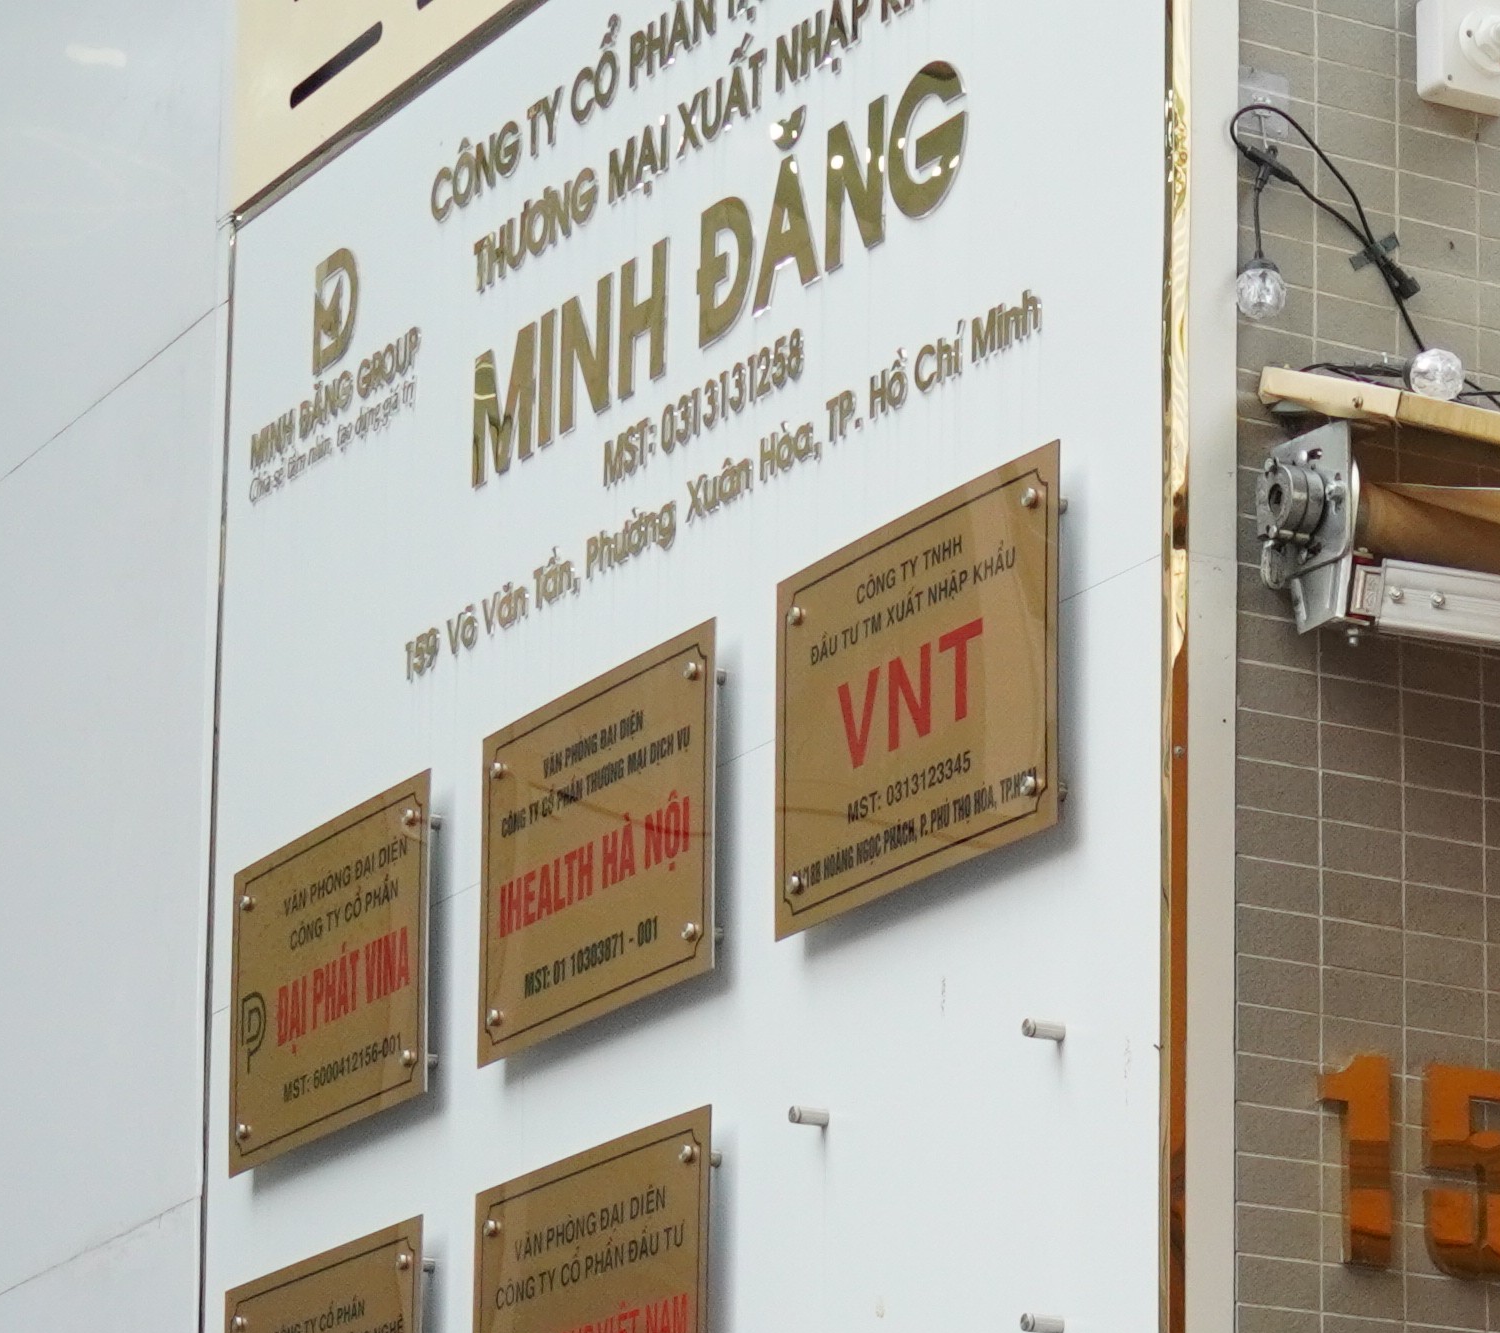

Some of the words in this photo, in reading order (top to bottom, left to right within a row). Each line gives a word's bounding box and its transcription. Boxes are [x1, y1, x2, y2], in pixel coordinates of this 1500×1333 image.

[431, 138, 522, 222] CÔNG
[527, 86, 564, 158] TY
[570, 14, 621, 125] CỔ
[473, 167, 599, 292] THƯƠNG
[608, 114, 671, 206] MẠI
[677, 33, 766, 159] XUẤT
[471, 236, 670, 489] MINH
[697, 60, 969, 349] ĐĂNG
[250, 408, 297, 472] MINH
[299, 370, 353, 440] ĐĂNG
[357, 326, 422, 400] GROUP
[603, 415, 657, 489] MST:
[661, 328, 806, 456] 0313131258
[404, 625, 440, 682] 159
[446, 603, 478, 657] Võ
[482, 578, 529, 637] Văn
[586, 500, 678, 578] Phường
[686, 458, 754, 524] Xuân
[826, 391, 864, 445] TP.
[869, 347, 910, 414] Hồ
[914, 319, 966, 394] Chí
[971, 288, 1044, 367] Minh
[810, 630, 839, 667] ĐẦU
[841, 624, 861, 651] TƯ
[863, 615, 882, 639] TM
[886, 587, 925, 626] XUẤT
[927, 568, 968, 608] NHẬP
[972, 540, 1017, 586] KHẨU
[856, 568, 897, 605] CÔNG
[900, 556, 919, 582] TY
[922, 534, 963, 571] TNHH
[649, 733, 674, 767] DỊCH
[677, 724, 691, 753] VỤ
[837, 617, 984, 770] VNT
[847, 791, 882, 825] MST:
[886, 750, 972, 806] 0313123345
[289, 917, 323, 951] CÔNG
[326, 908, 342, 933] TY
[344, 886, 362, 923] CỔ
[365, 873, 399, 914] PHẦN
[499, 841, 594, 939] IHEALTH
[601, 812, 637, 889] HÀ
[644, 789, 690, 872] NỘI
[276, 976, 308, 1056] ĐẠI
[312, 941, 360, 1031] PHÁT
[365, 926, 411, 1004] VINA
[524, 965, 551, 999] MST:
[553, 958, 567, 986] 01
[637, 916, 658, 947] 001
[284, 1074, 311, 1103] MST:
[495, 1275, 535, 1311] CÔNG
[539, 1267, 557, 1295] TY
[560, 1246, 581, 1287] CỔ
[584, 1236, 624, 1278] PHẦN
[628, 1226, 660, 1263] ĐẦU
[663, 1219, 685, 1250] TƯ
[547, 1212, 596, 1250] PHÒNG
[600, 1205, 624, 1232] ĐẠI
[630, 1184, 666, 1220] DIỆN
